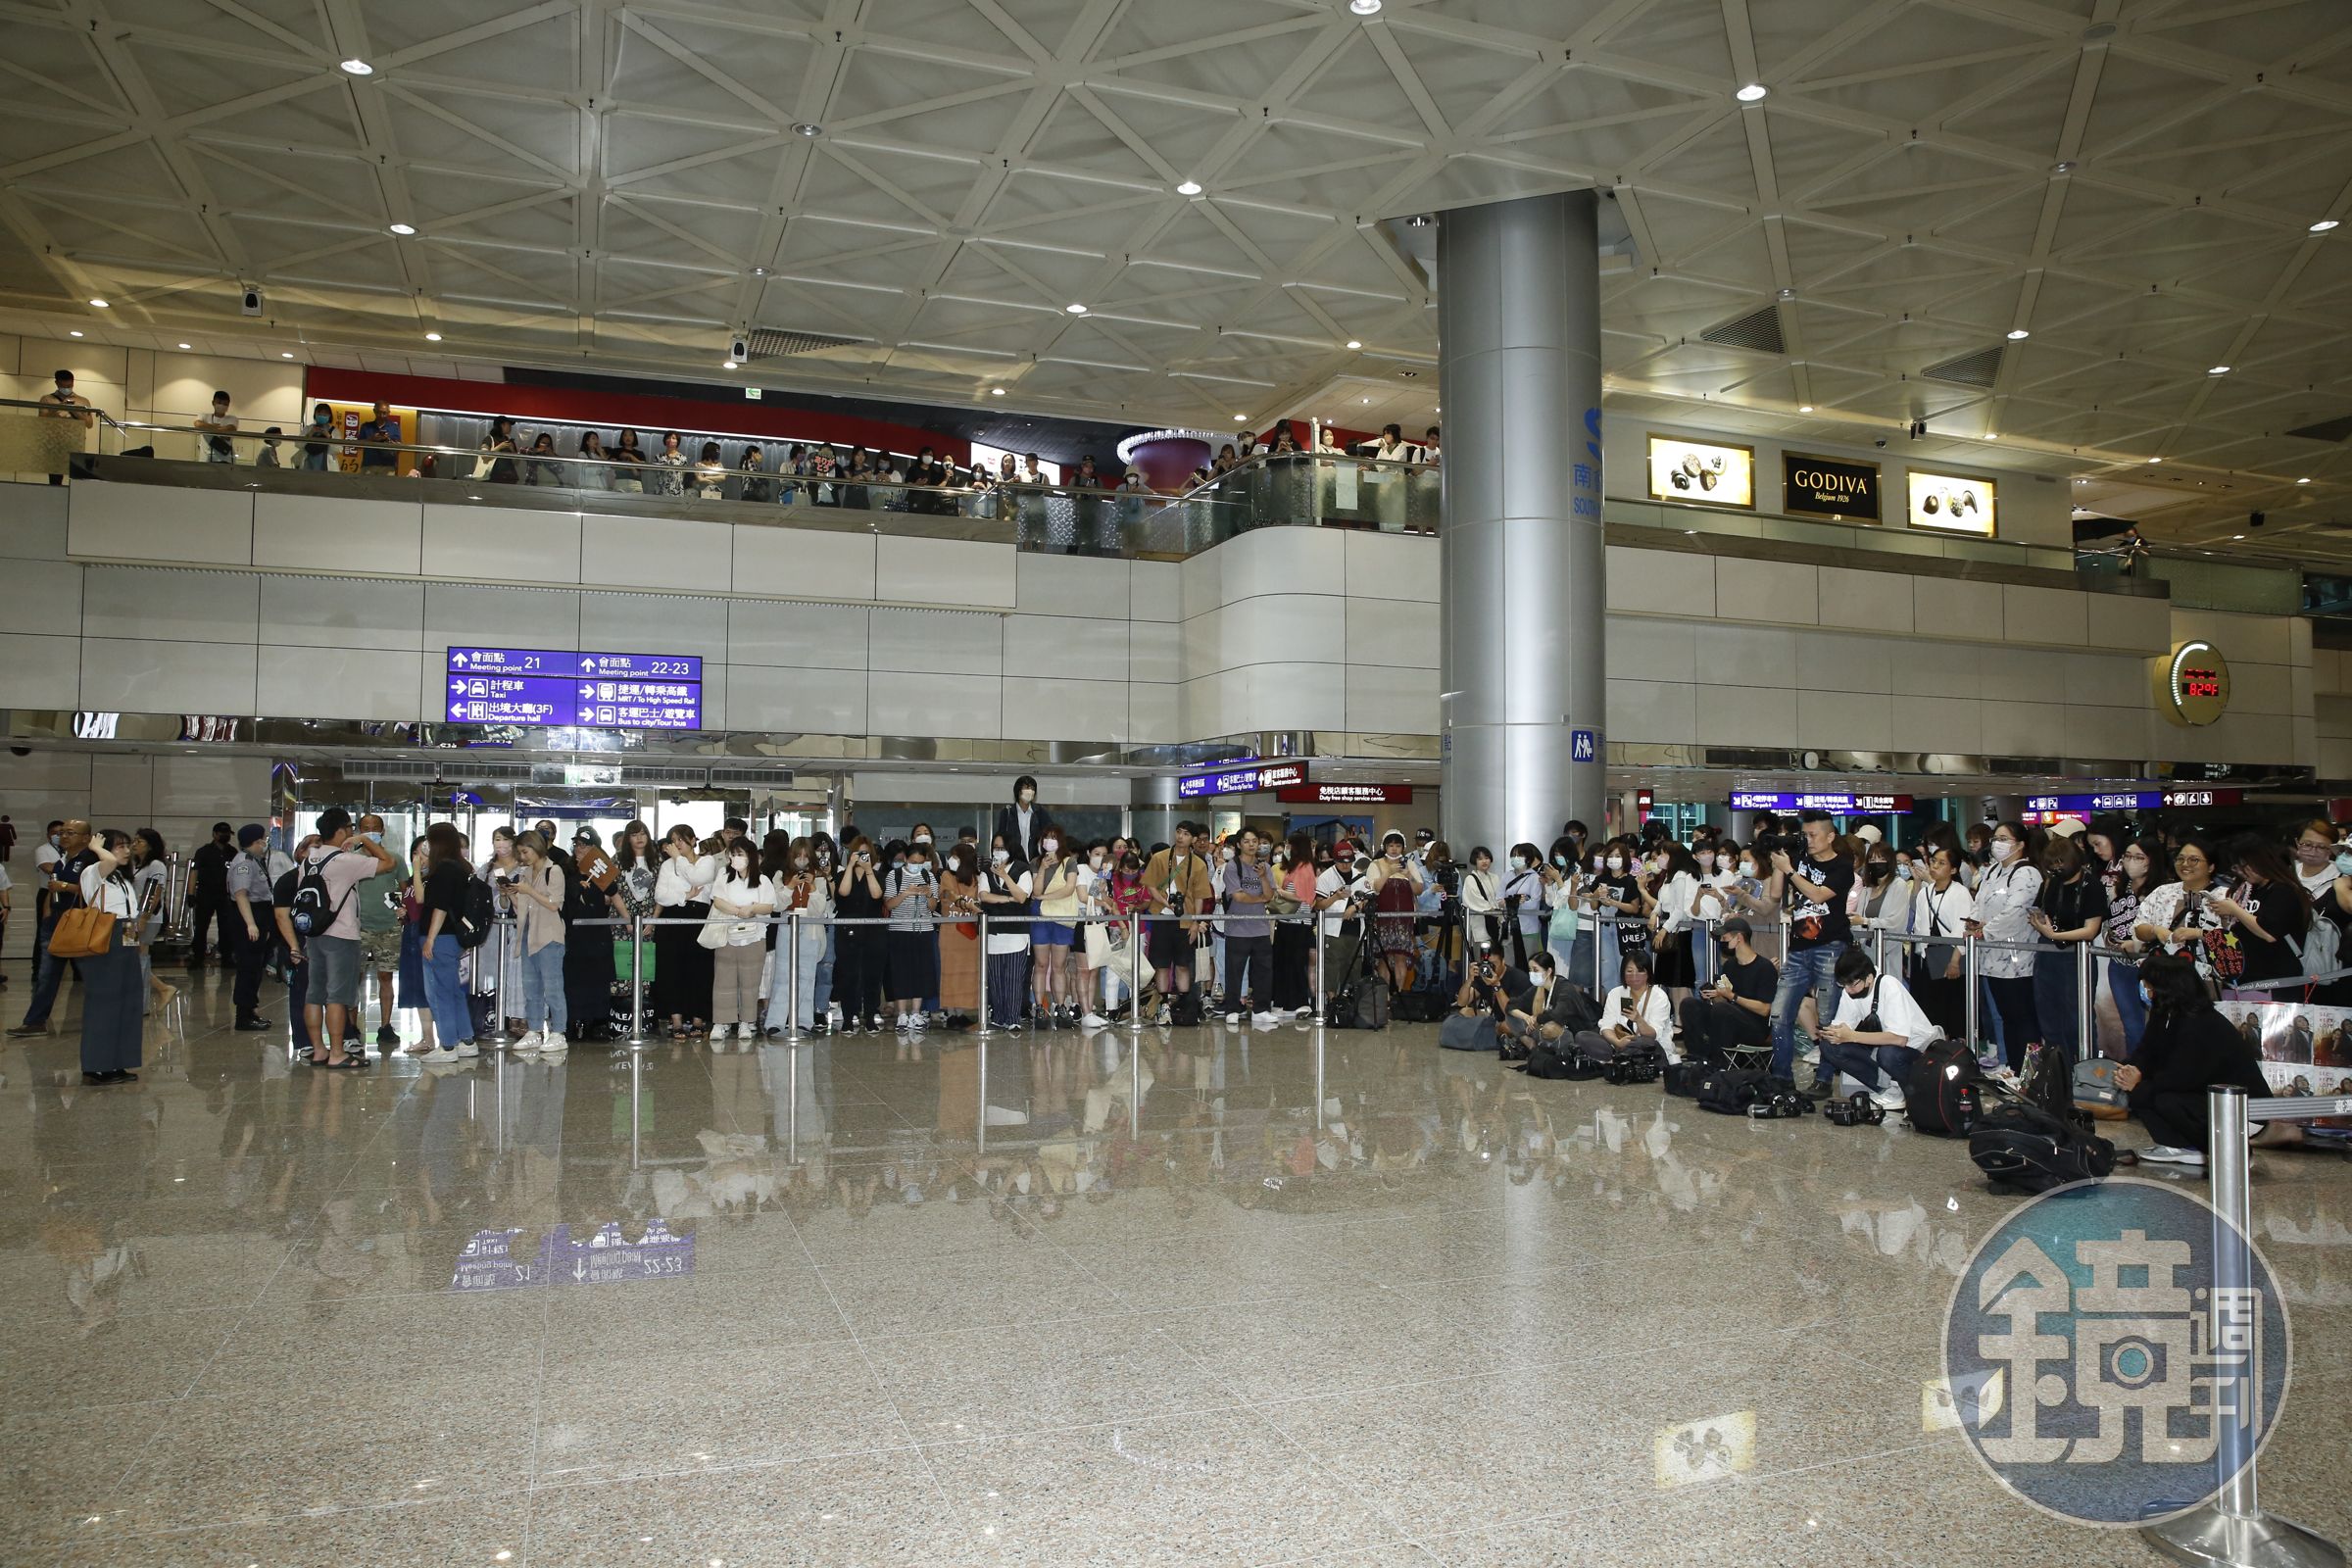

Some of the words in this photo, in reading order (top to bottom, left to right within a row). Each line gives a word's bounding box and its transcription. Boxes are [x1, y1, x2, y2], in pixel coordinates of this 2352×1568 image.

[1794, 469, 1867, 495] GODIVA
[1815, 491, 1836, 502] Belgium
[1837, 494, 1849, 503] 1926
[470, 651, 505, 662] 會面點
[524, 656, 540, 669] 21
[599, 656, 631, 668] 會面點
[651, 662, 690, 675] 22-23
[469, 662, 501, 672] Meeting
[502, 664, 522, 673] point
[599, 667, 628, 677] Meeting
[629, 669, 649, 678] point
[490, 679, 524, 691] 計程車
[646, 696, 662, 705] High
[662, 697, 683, 706] Speed
[489, 713, 526, 722] Departure
[641, 718, 672, 727] city/Tour
[2109, 895, 2137, 916] 山Pの
